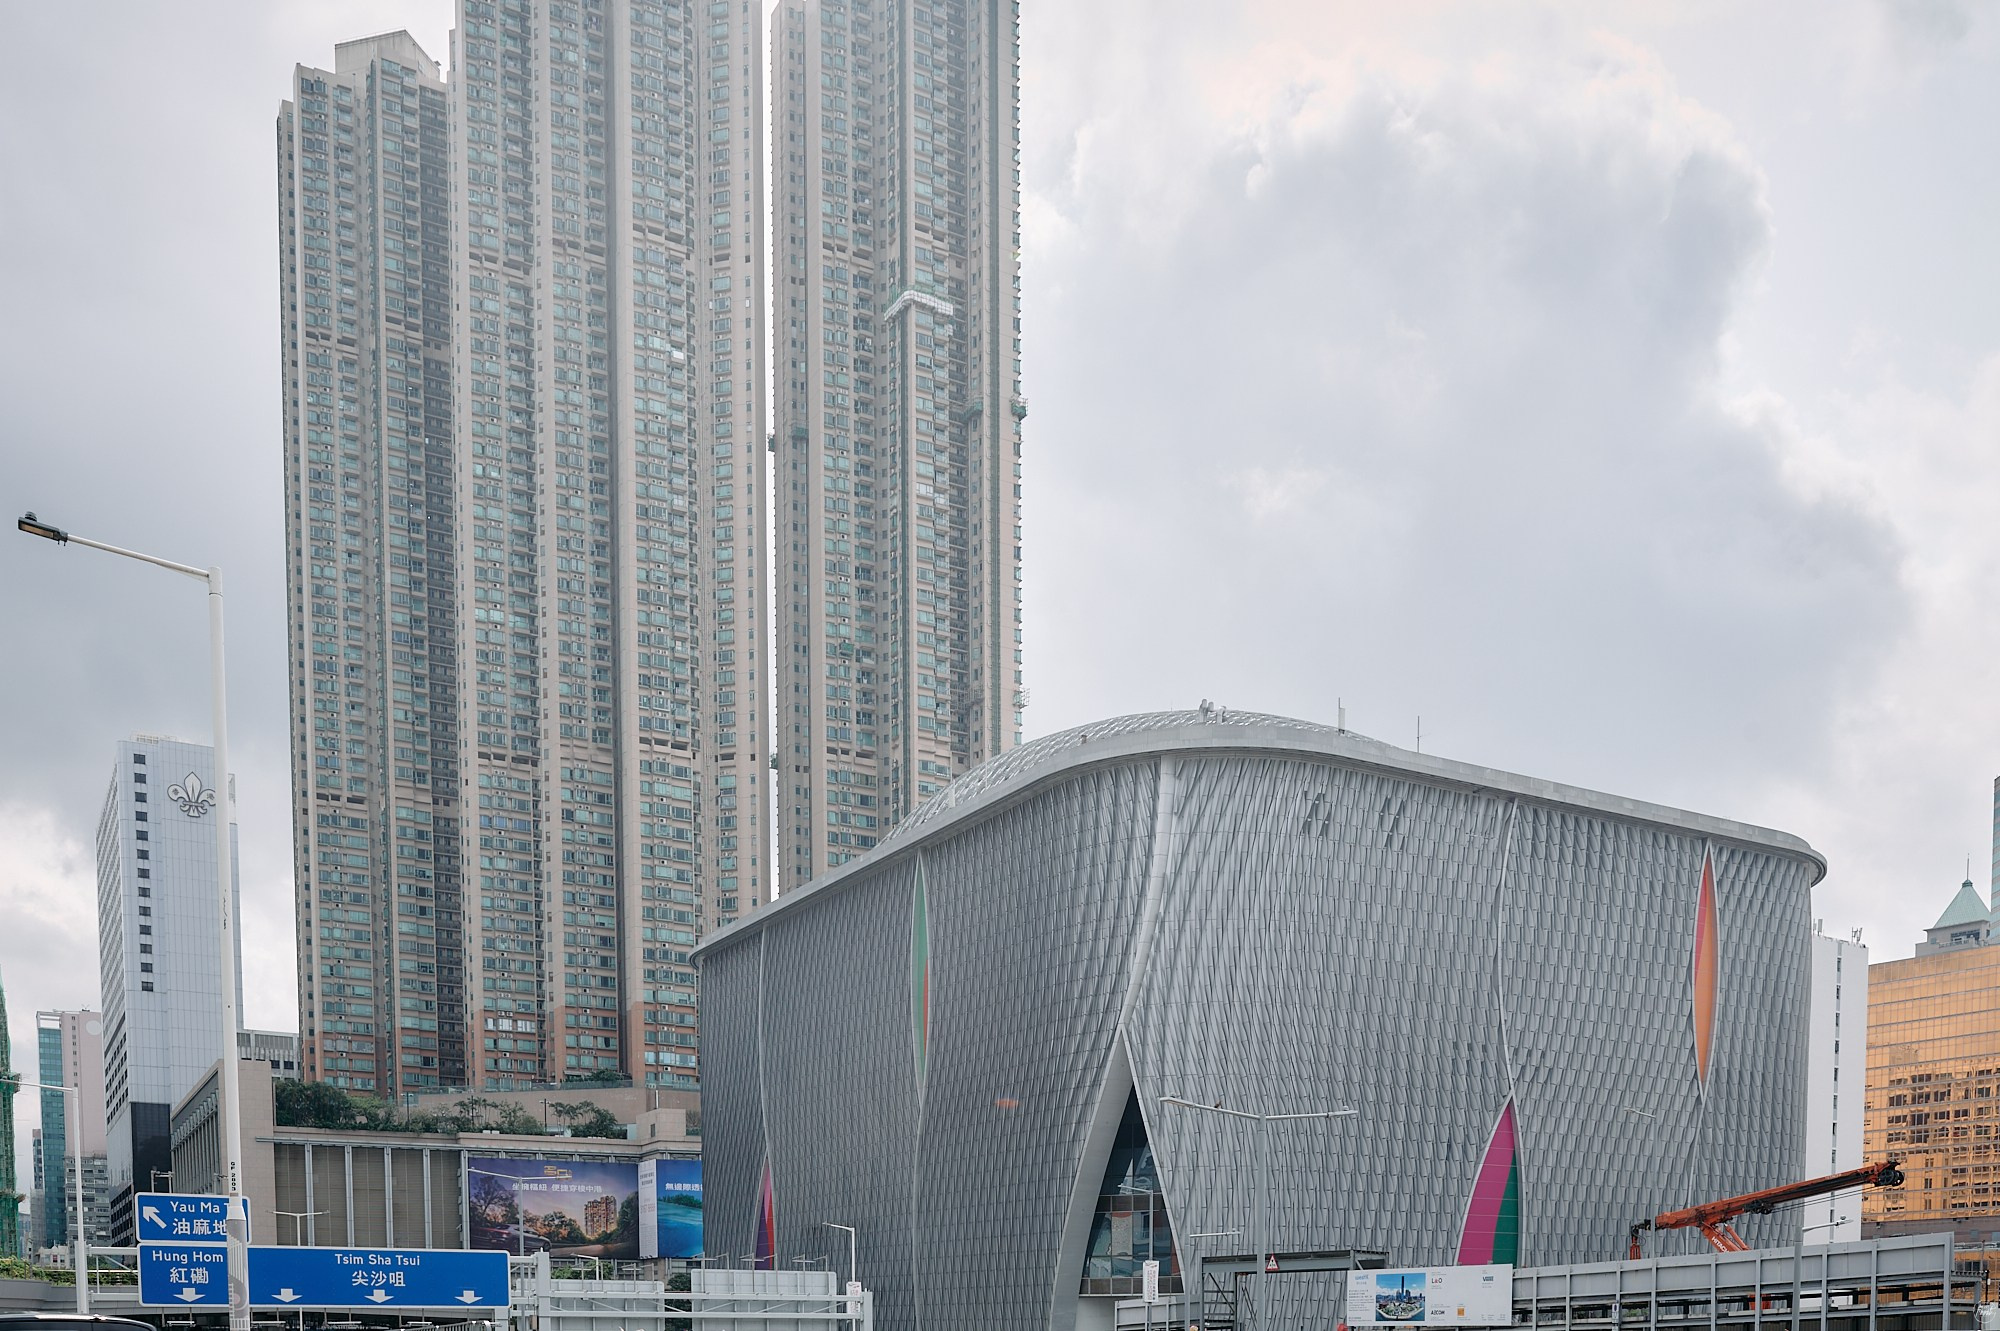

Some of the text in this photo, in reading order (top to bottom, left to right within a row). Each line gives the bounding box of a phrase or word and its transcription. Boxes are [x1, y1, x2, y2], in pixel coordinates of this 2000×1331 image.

[170, 1201, 195, 1213] Yau
[200, 1202, 220, 1213] Ma
[172, 1218, 227, 1236] 油麻地
[152, 1250, 224, 1264] Hung Hom
[334, 1253, 420, 1266] Tsim Sha Tsui
[169, 1267, 209, 1284] 紅磡
[352, 1270, 406, 1287] 尖沙咀
